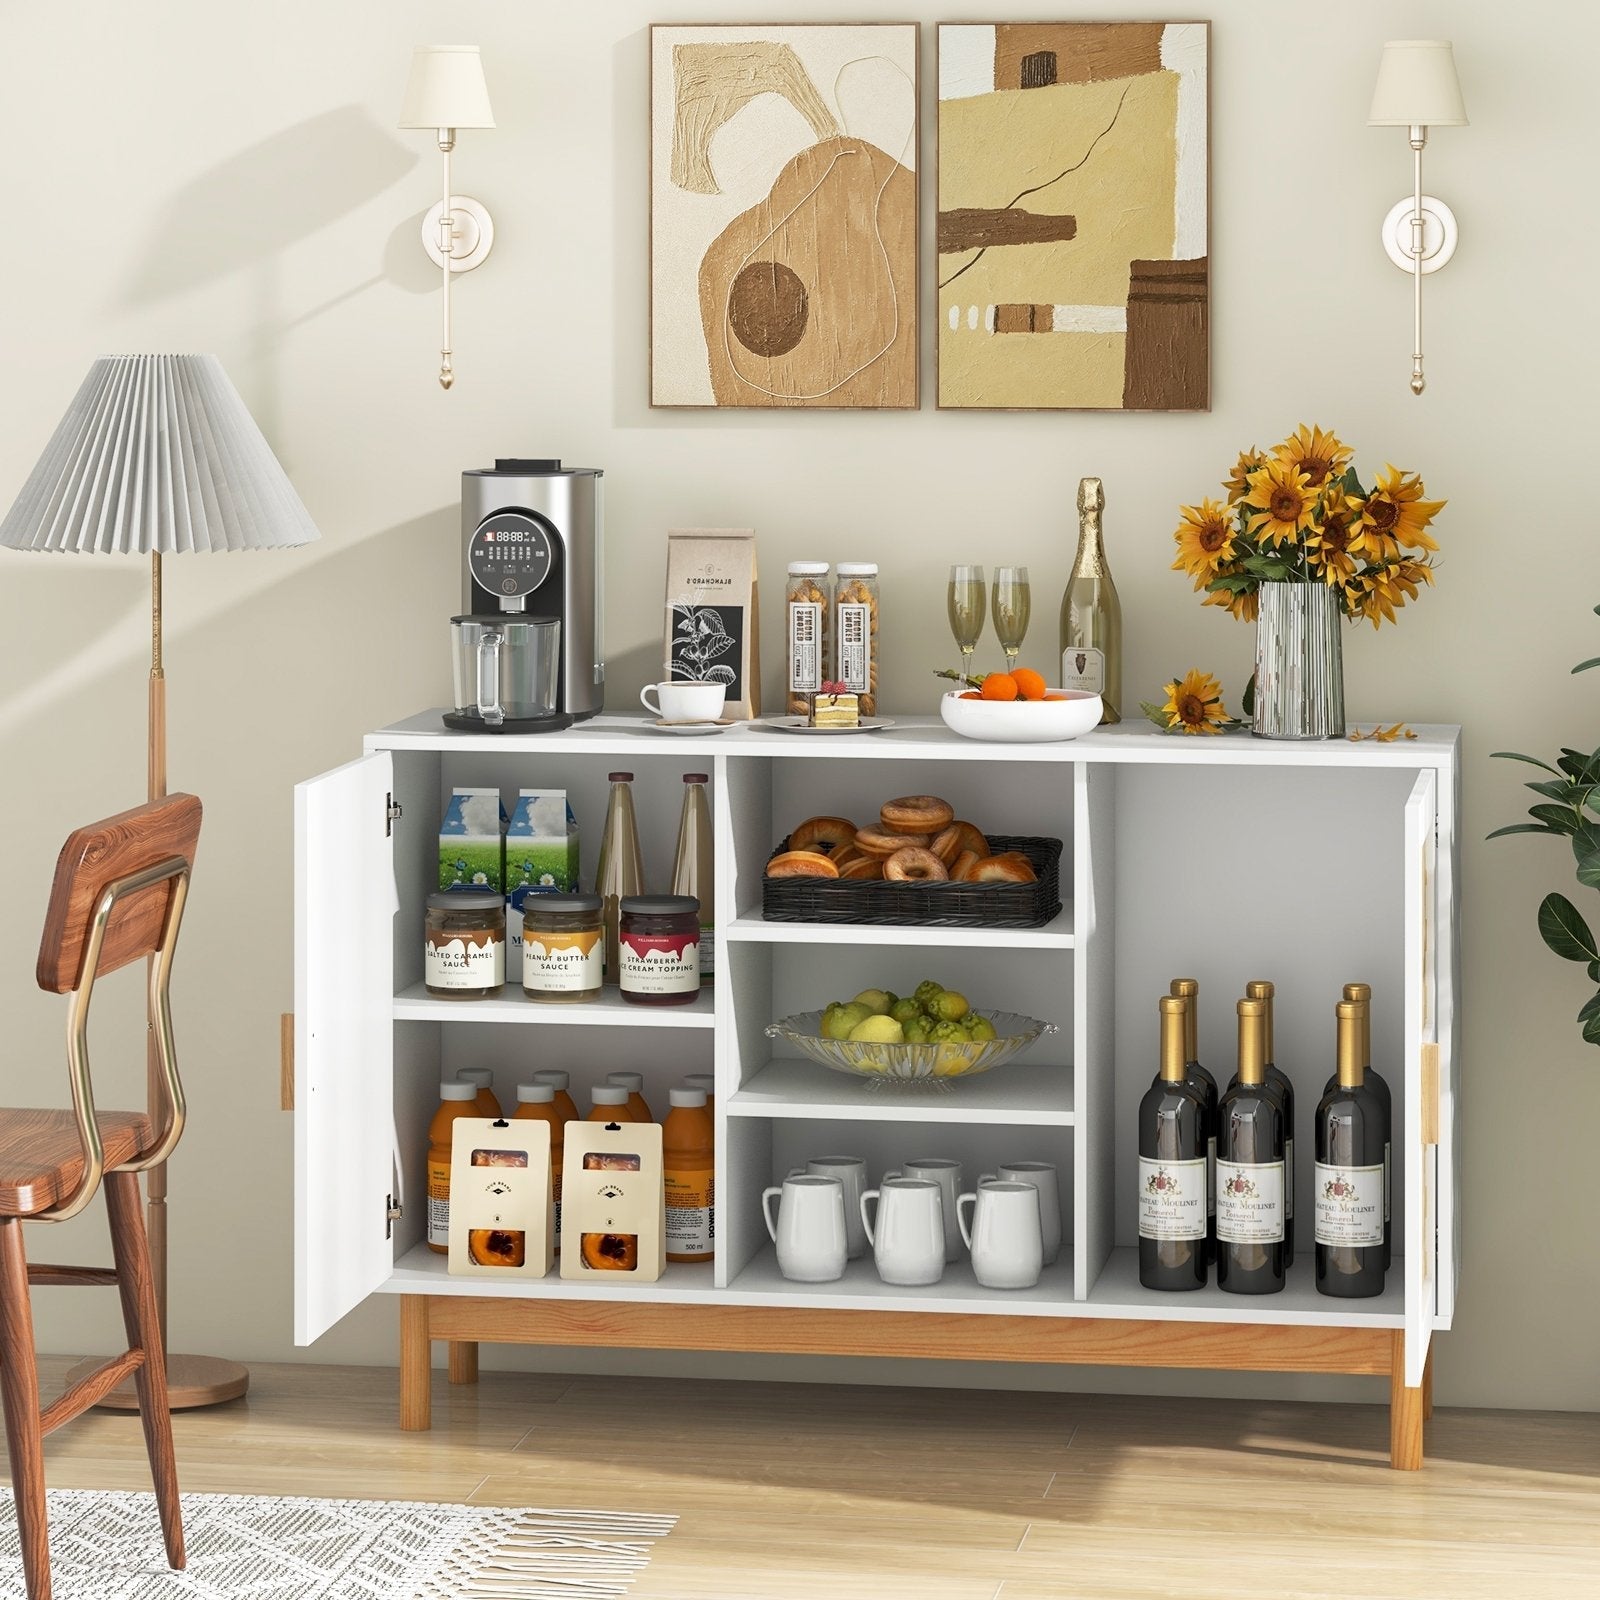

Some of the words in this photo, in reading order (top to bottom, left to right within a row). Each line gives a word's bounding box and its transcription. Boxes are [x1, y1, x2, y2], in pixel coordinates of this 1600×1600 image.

[454, 952, 493, 960] CARAMEL
[526, 953, 553, 961] PEANUT
[627, 956, 681, 964] STRAWBERRY
[658, 964, 693, 972] TOPPING
[1162, 1197, 1198, 1206] MOULINET
[1240, 1200, 1276, 1210] MOULINET
[1340, 1203, 1375, 1213] MOULINET
